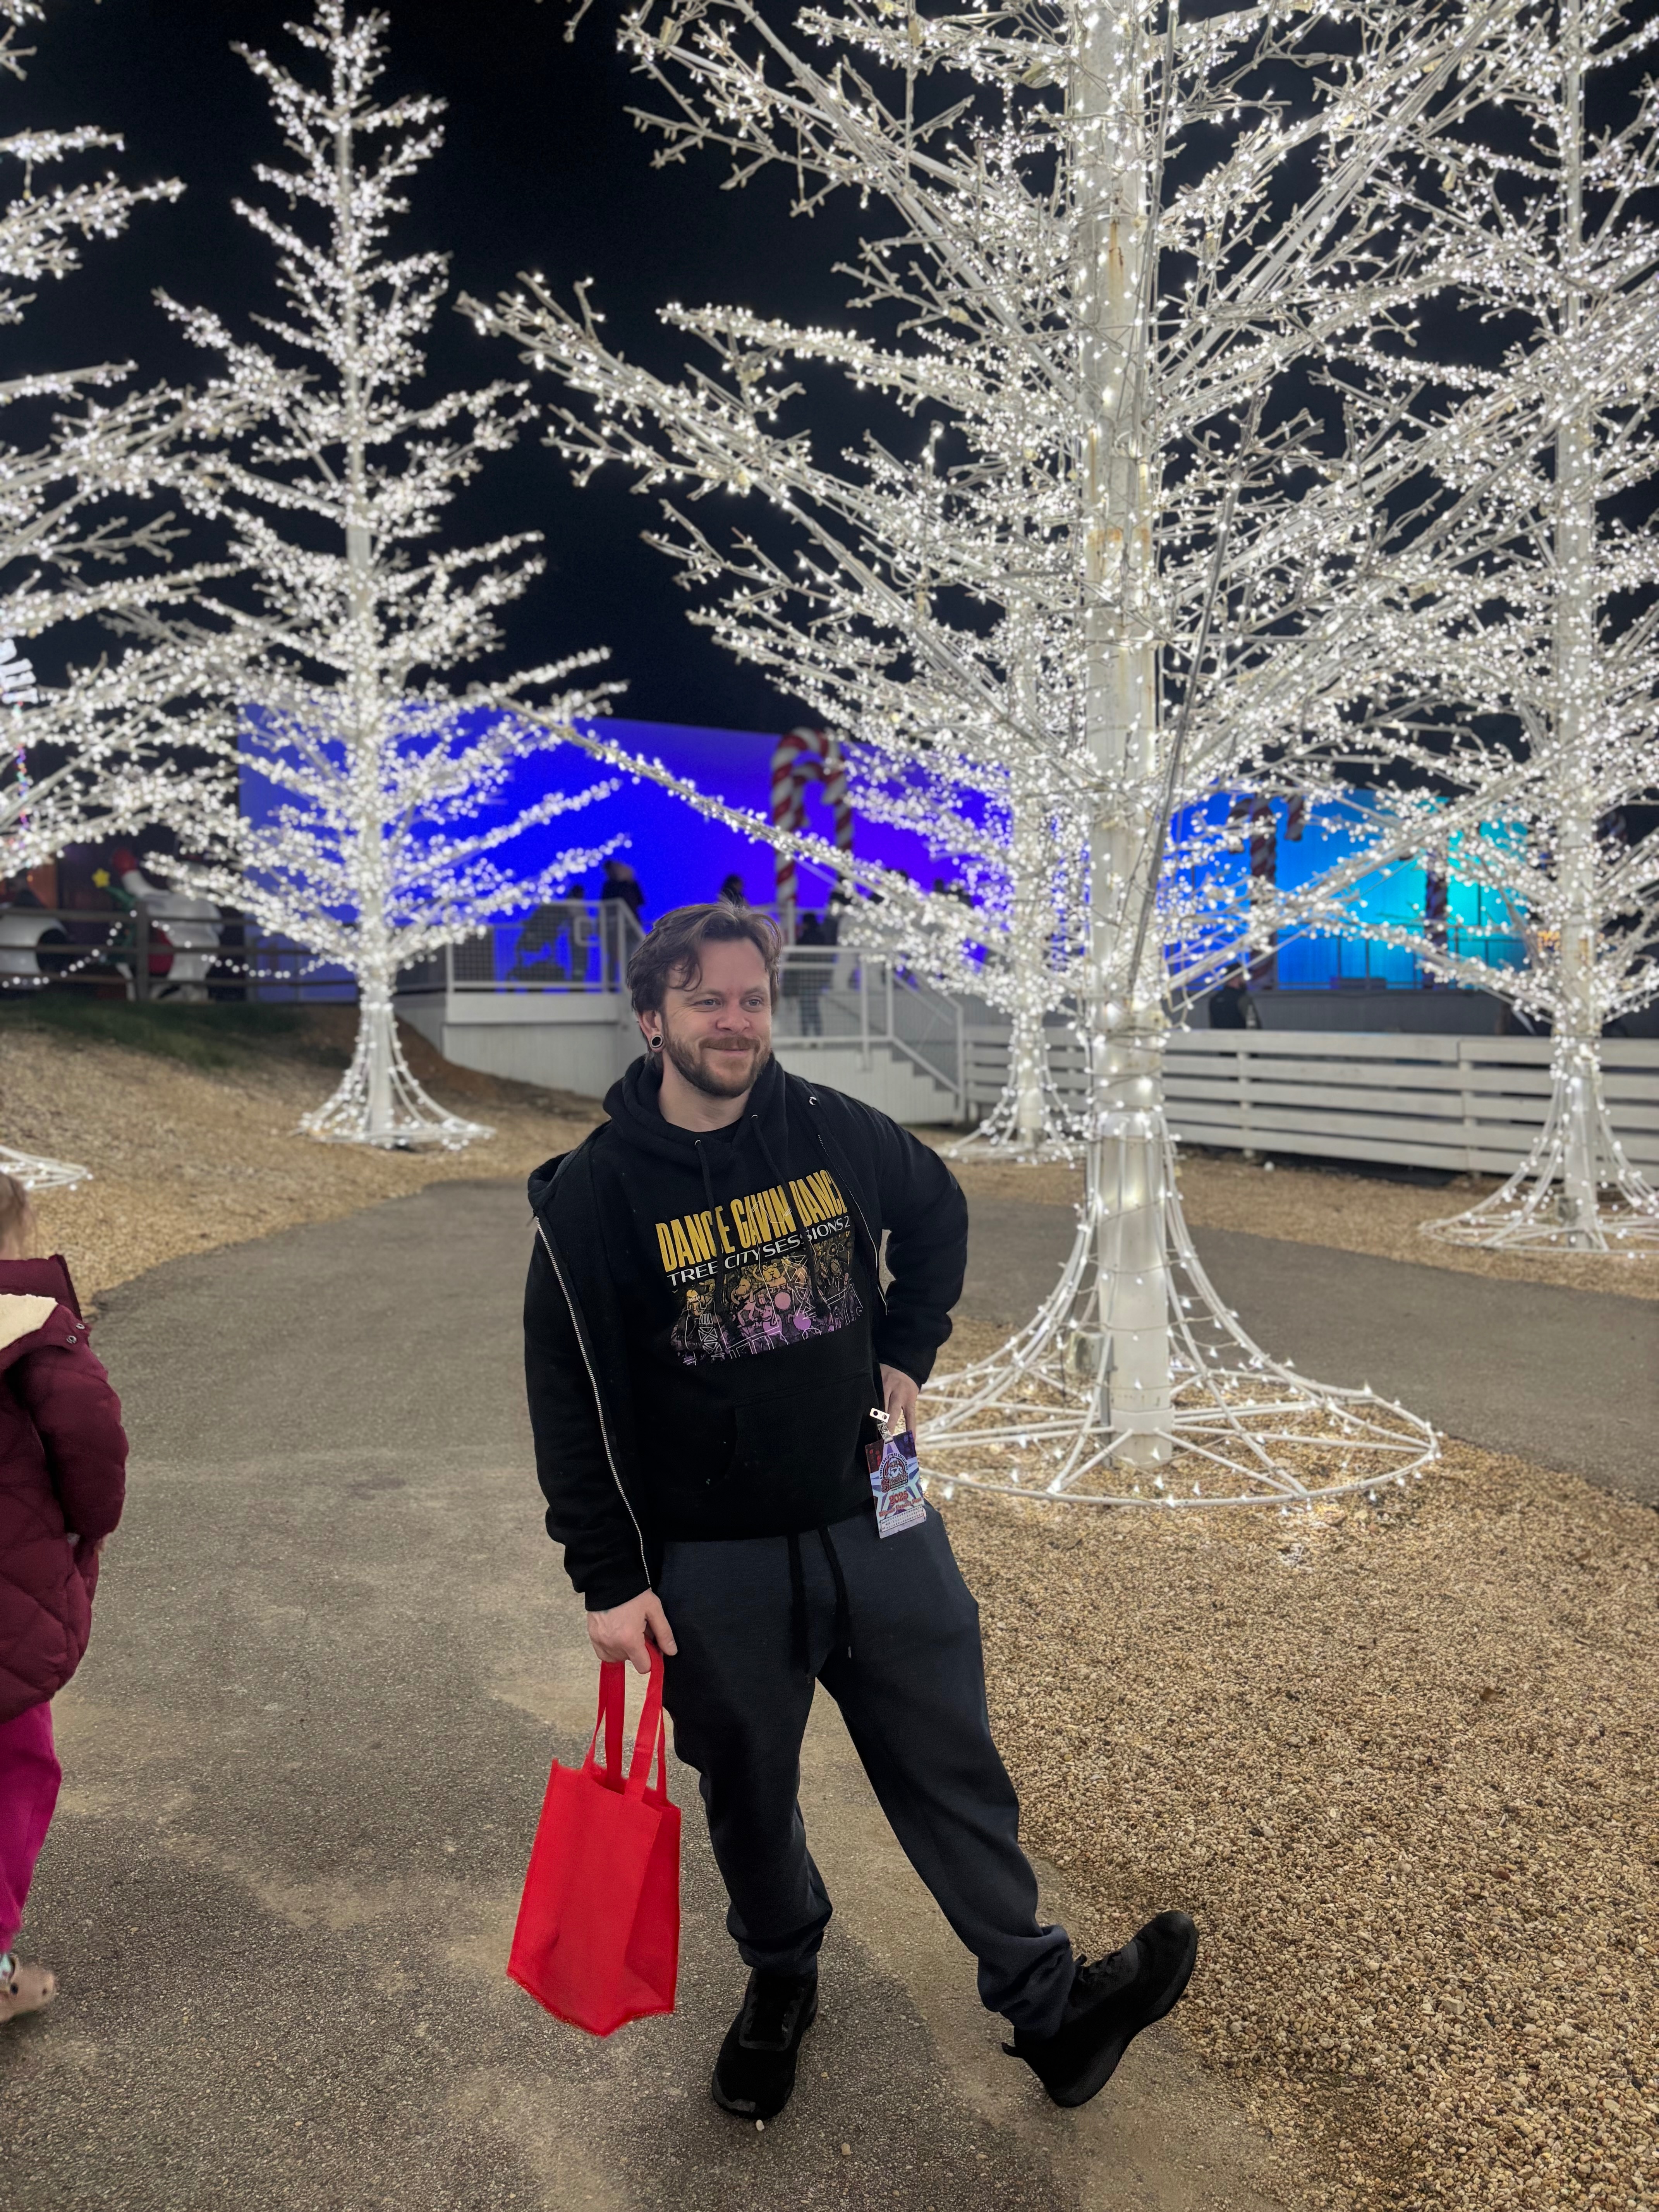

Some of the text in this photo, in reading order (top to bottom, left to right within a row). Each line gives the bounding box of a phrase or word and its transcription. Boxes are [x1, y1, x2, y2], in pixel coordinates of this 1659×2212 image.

[655, 1205, 736, 1273] DANCE
[730, 1185, 797, 1249] GAVIN
[666, 1260, 718, 1286] TREE
[724, 1247, 761, 1269] CITY
[889, 1490, 908, 1506] 2025
